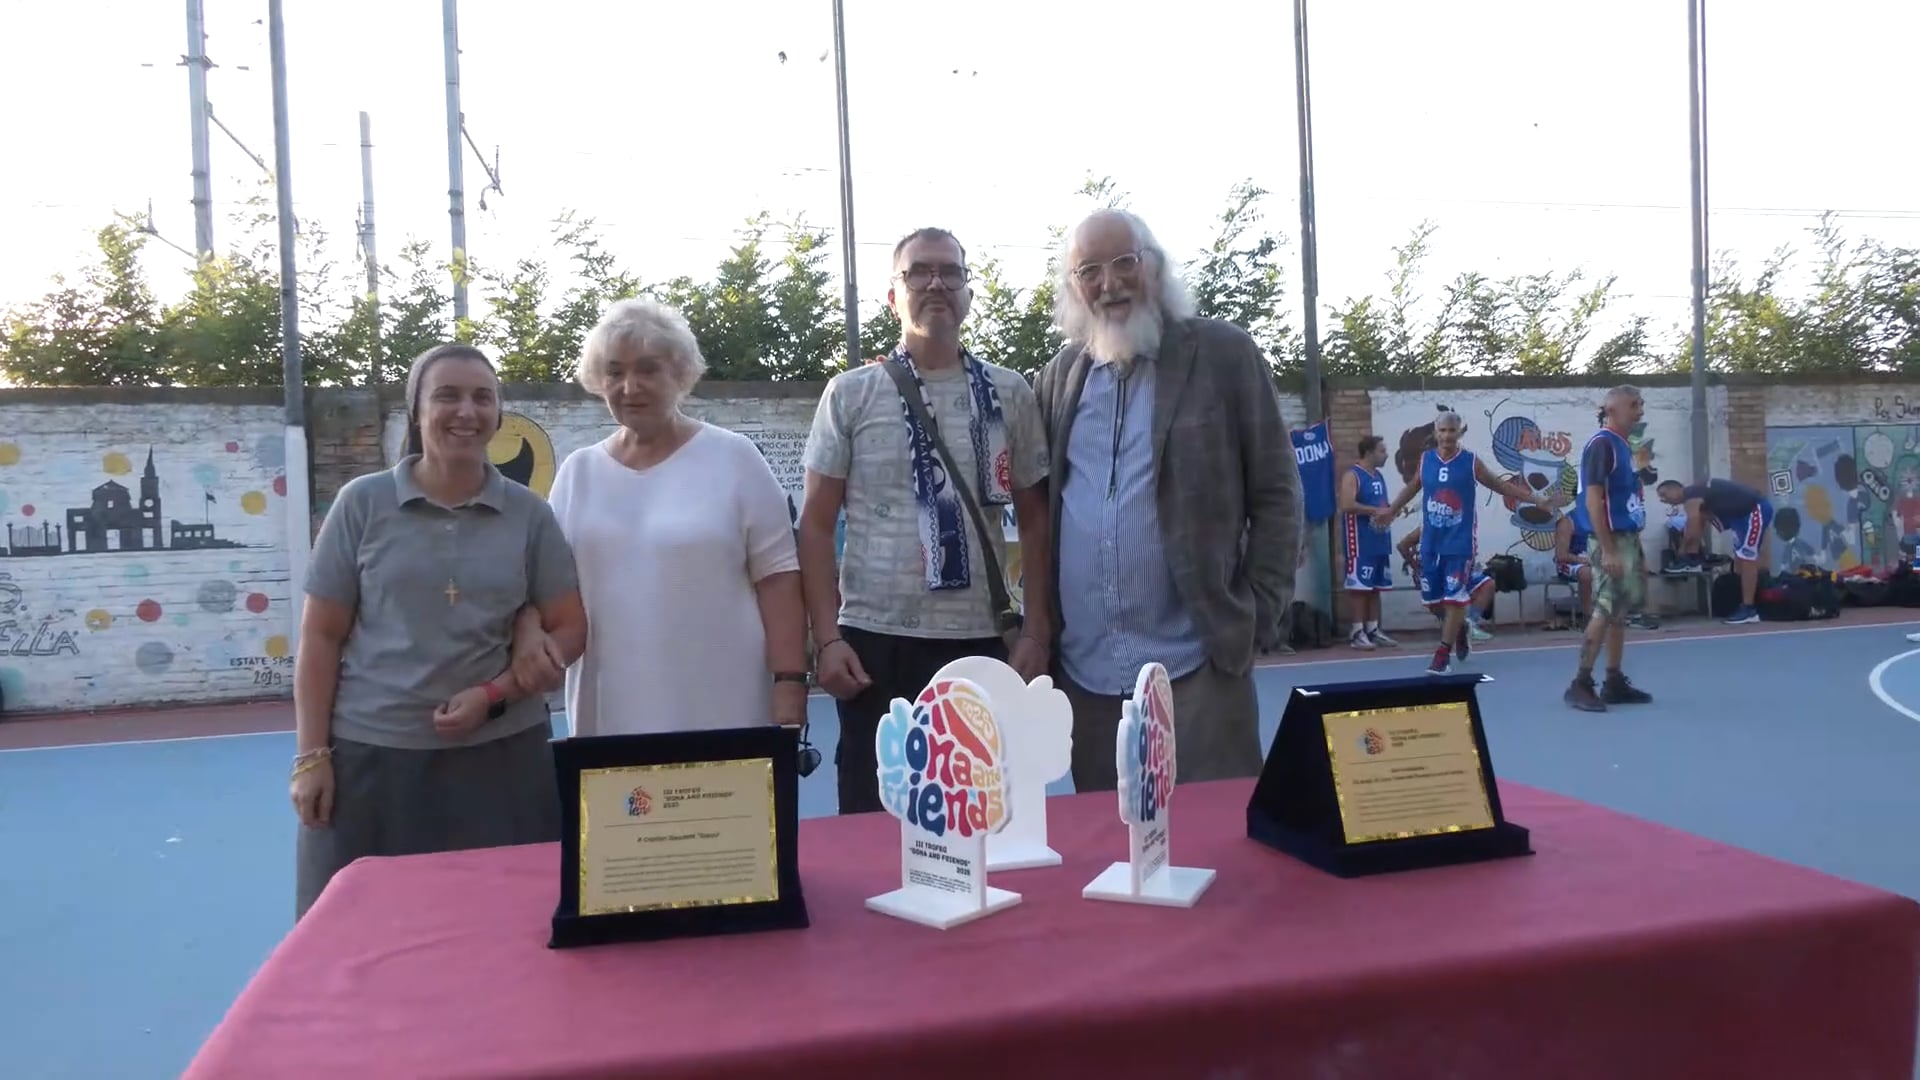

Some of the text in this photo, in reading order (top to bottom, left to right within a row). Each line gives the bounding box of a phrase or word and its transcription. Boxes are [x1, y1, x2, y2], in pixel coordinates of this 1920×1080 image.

[1439, 467, 1449, 482] 6
[1361, 566, 1374, 580] 37
[230, 656, 267, 666] ESTATE
[254, 670, 282, 685] 2019
